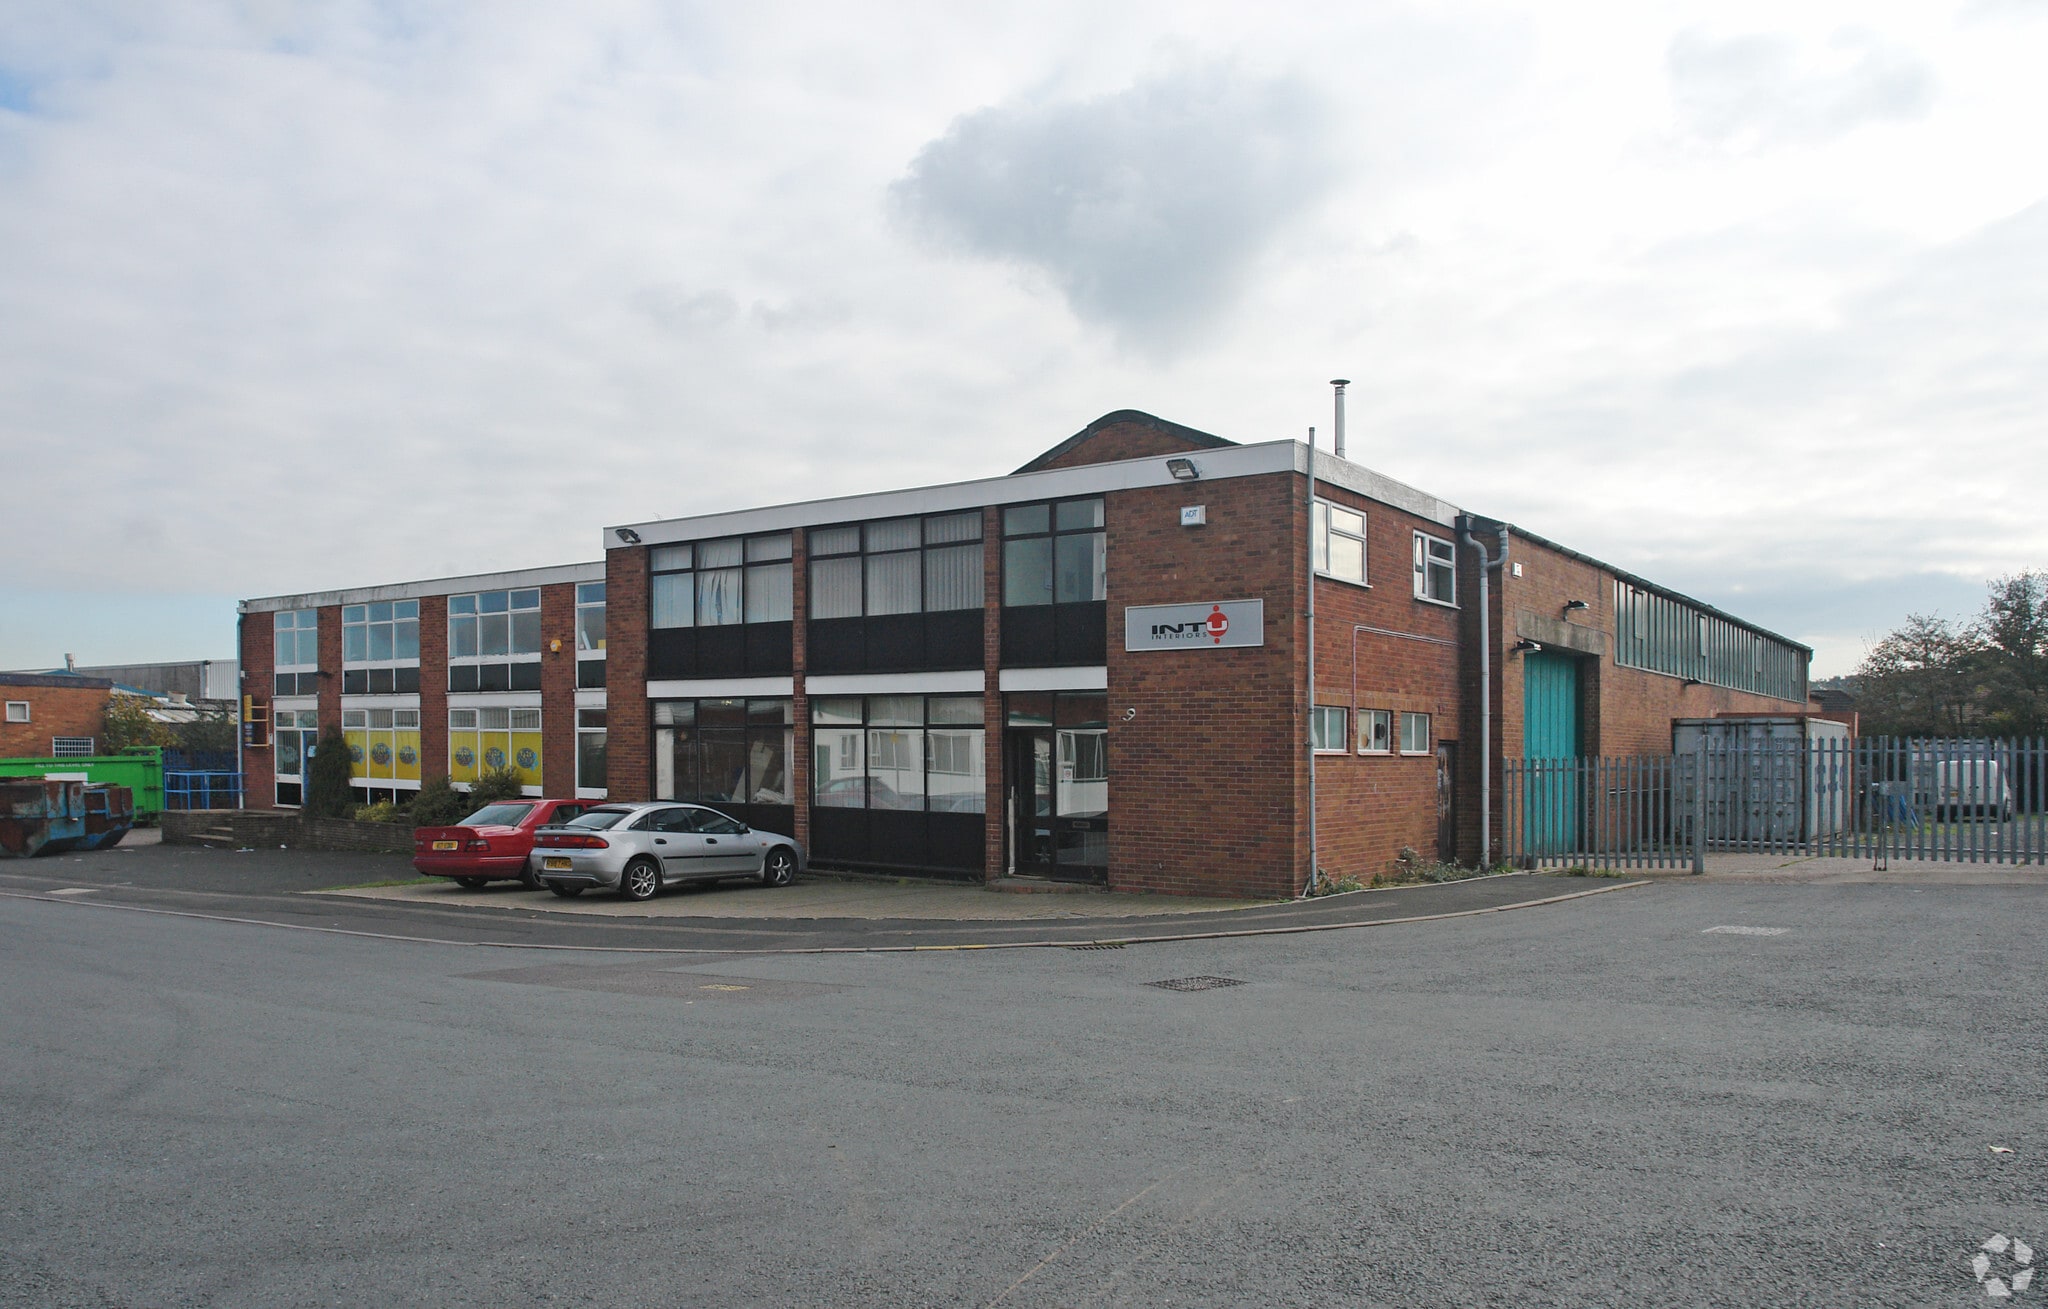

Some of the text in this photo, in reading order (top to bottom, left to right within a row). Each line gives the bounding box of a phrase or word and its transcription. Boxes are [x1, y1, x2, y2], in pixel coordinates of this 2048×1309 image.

[1184, 509, 1198, 518] ADT
[1151, 620, 1228, 635] INTU
[1151, 632, 1207, 640] INTERIORS
